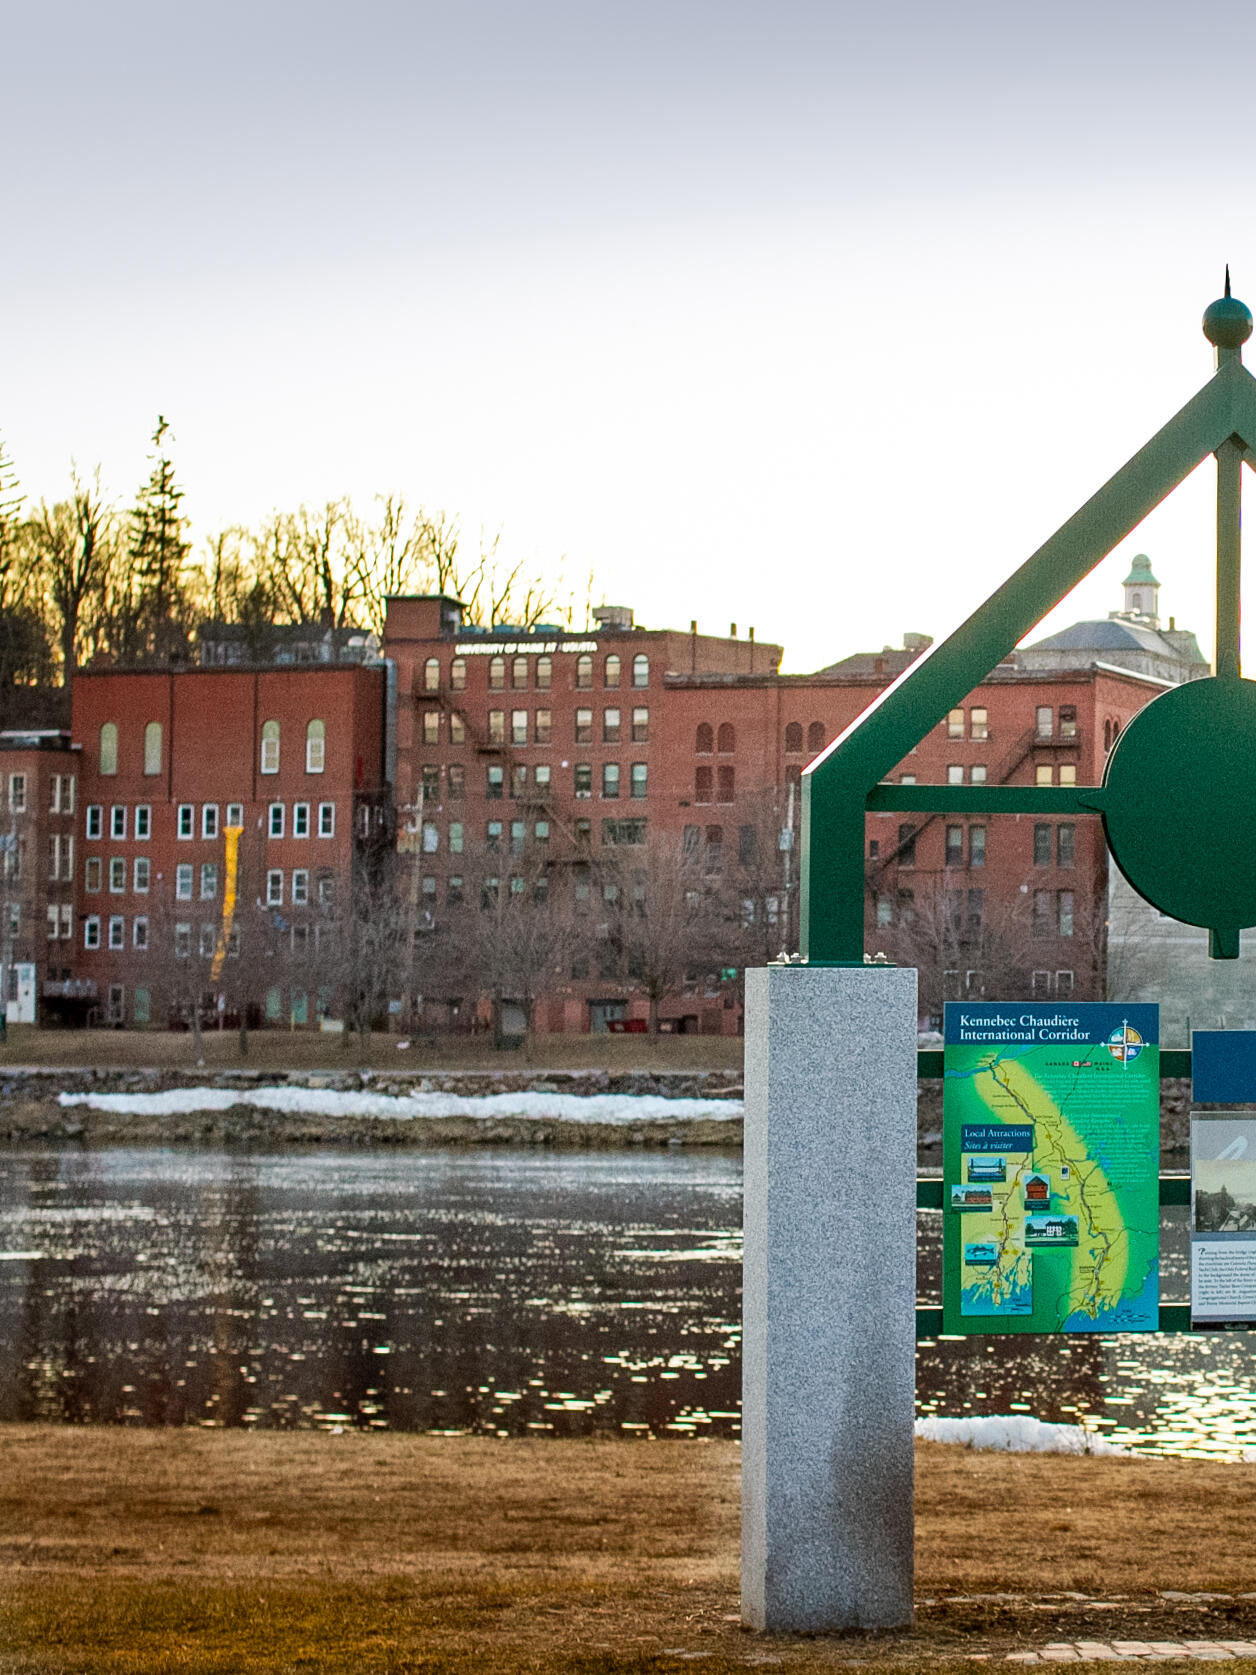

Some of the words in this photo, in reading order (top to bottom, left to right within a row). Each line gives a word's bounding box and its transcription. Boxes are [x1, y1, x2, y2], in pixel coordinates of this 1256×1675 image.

[545, 641, 557, 653] AT
[557, 641, 598, 653] UGUSTA
[960, 1014, 1017, 1027] Kennebec
[1019, 1014, 1080, 1027] Chaudière
[960, 1028, 1035, 1040] International
[1038, 1028, 1091, 1040] Corridor
[965, 1128, 985, 1137] Local
[988, 1128, 1030, 1137] Attractions
